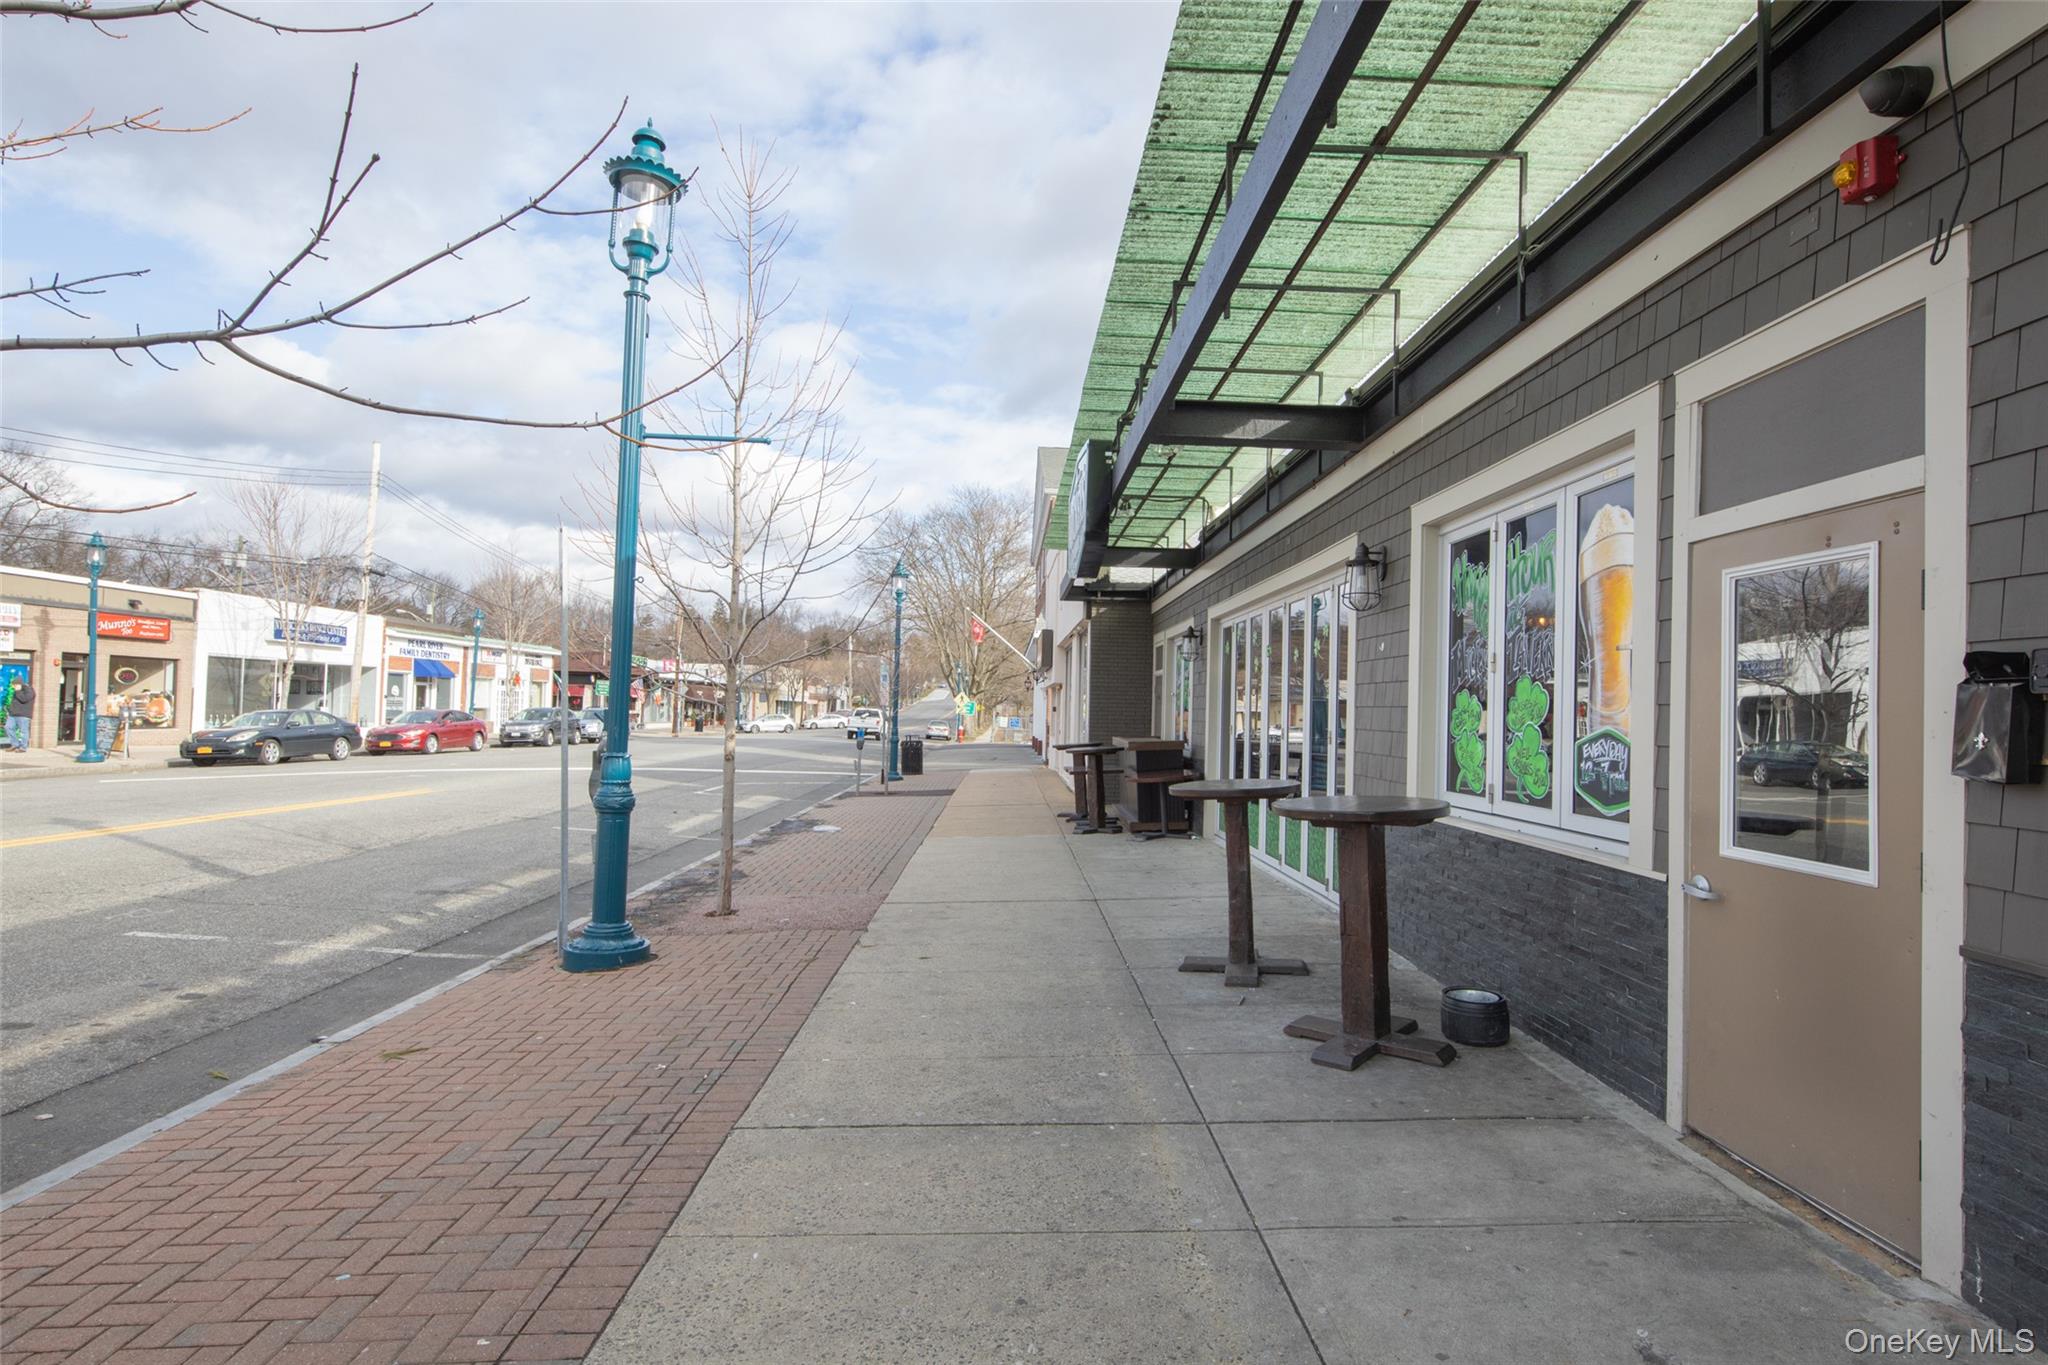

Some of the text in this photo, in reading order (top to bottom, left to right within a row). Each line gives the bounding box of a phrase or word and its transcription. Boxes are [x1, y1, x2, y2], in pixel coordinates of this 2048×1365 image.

[408, 639, 444, 650] PEARL RIVER
[400, 648, 450, 659] FAMILY DENTISTRY
[1582, 738, 1628, 773] EVERYDAY
